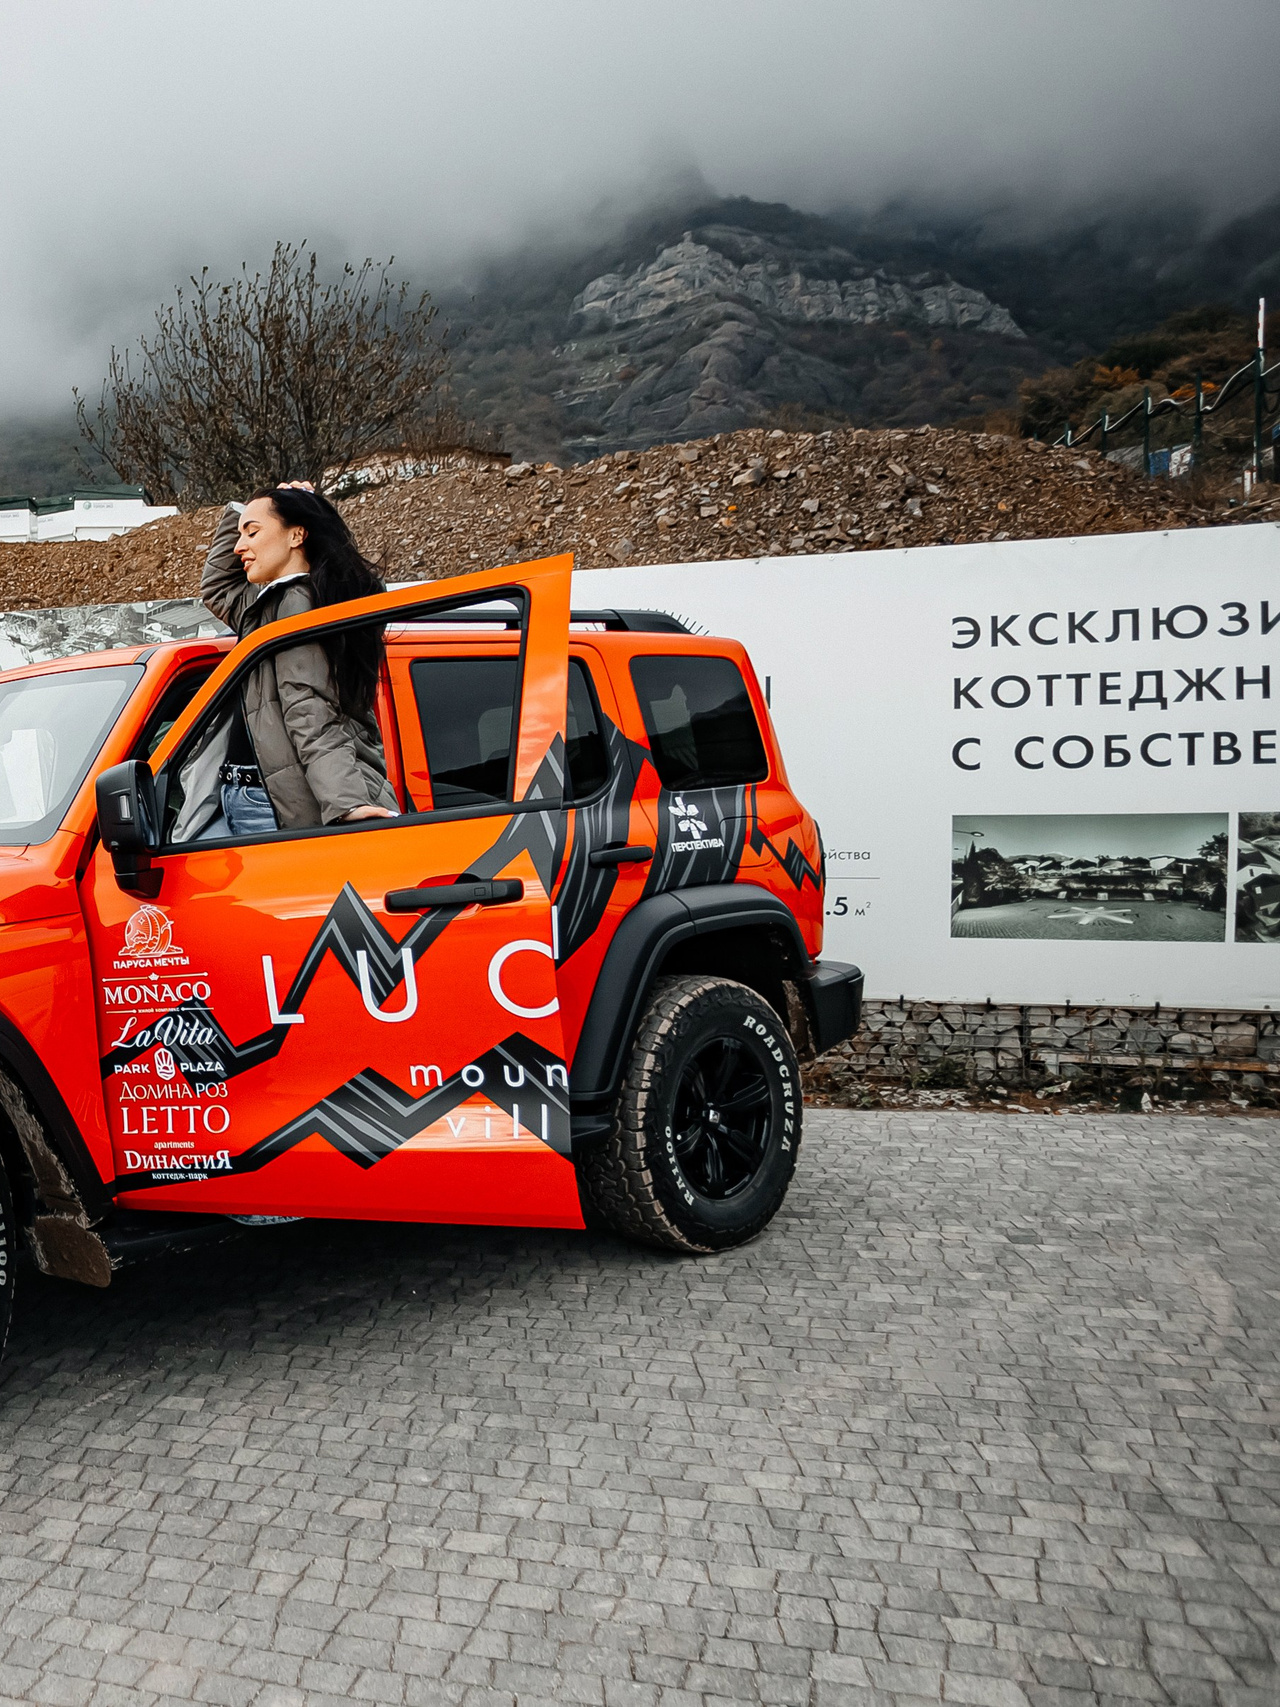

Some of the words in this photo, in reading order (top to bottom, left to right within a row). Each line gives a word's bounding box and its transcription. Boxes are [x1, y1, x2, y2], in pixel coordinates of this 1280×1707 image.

[953, 665, 1271, 711] КОТТЕДЖН
[951, 737, 982, 770] С
[1014, 729, 1278, 769] СОБСТВЕ
[671, 838, 725, 853] ПЕРСПЕКТИВА
[113, 959, 152, 969] ПАРУСА
[153, 956, 190, 967] МЕЧТЫ
[103, 981, 212, 1005] MONACO
[114, 1063, 151, 1074] PARK
[179, 1061, 224, 1073] PLAZA
[119, 1081, 193, 1102] ДОЛИНА
[195, 1081, 229, 1098] РОЗ
[742, 1014, 796, 1153] ROADCRUZA
[120, 1104, 231, 1135] LETTO
[153, 1141, 195, 1151] apartments
